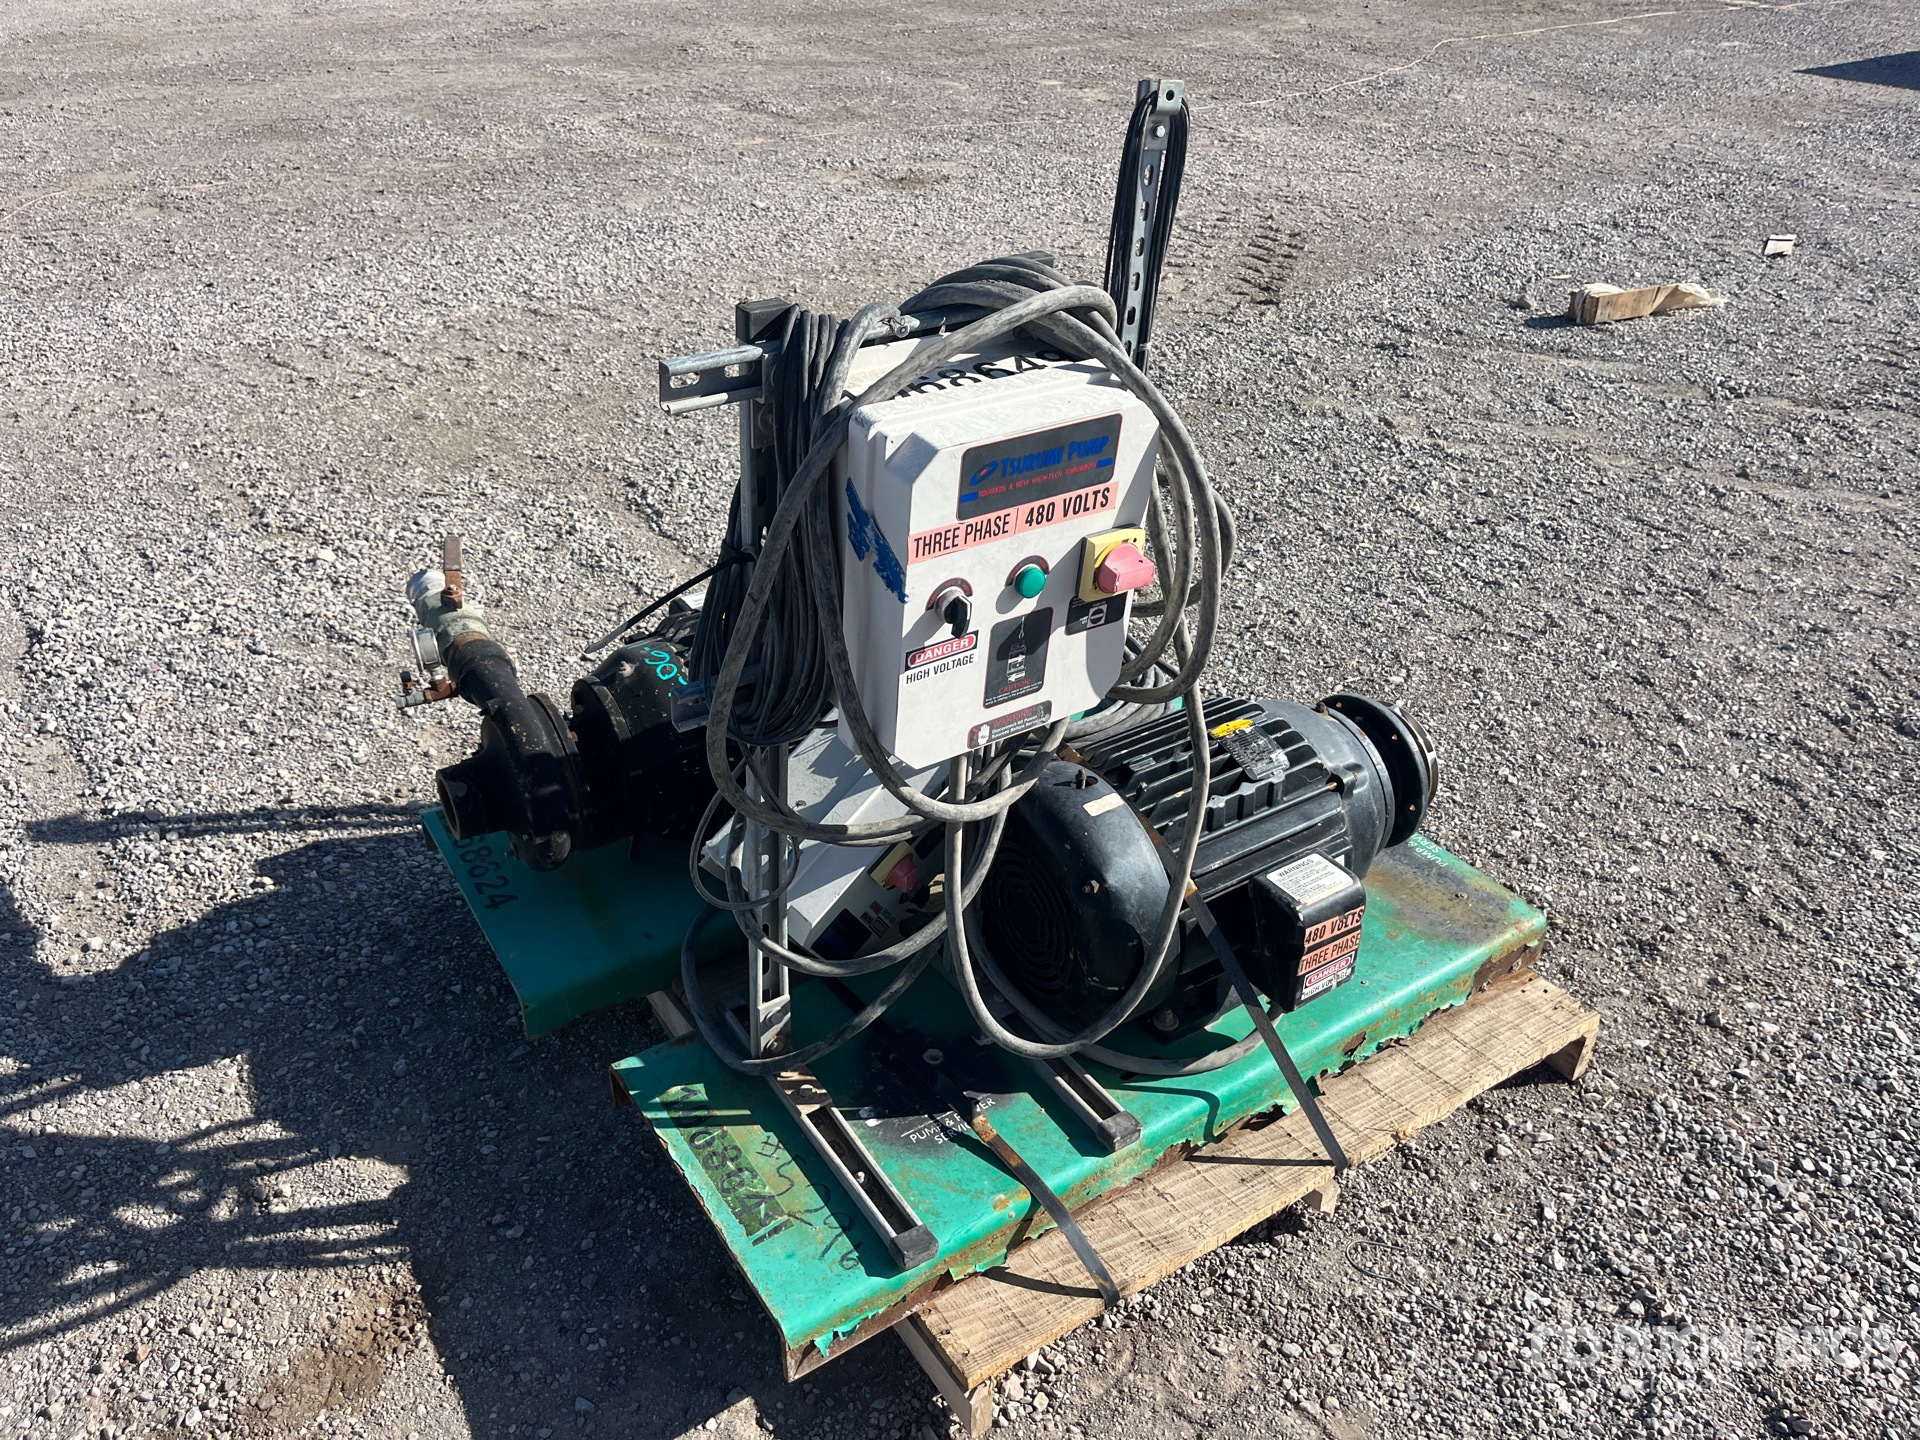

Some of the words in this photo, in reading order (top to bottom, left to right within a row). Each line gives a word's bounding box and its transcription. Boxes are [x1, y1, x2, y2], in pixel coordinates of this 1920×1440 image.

[1000, 445, 1064, 478] TSURUMI
[1067, 435, 1110, 461] PUMP
[978, 484, 1007, 497] TOWARDS
[1015, 479, 1030, 488] NEW
[1065, 462, 1097, 475] TOMORROW
[914, 526, 961, 558] THREE
[964, 513, 1011, 544] PHASE
[1025, 501, 1056, 527] 480
[1062, 487, 1111, 518] VOLTS
[915, 638, 969, 663] DANGER
[905, 668, 930, 685] HIGH
[933, 653, 975, 675] VOLTAGE
[1277, 858, 1314, 878] WARNINGS
[1415, 847, 1449, 868] PUMP
[1305, 924, 1326, 945] 480
[1330, 908, 1364, 934] VOLTS
[1300, 947, 1330, 973] THREE
[1331, 932, 1361, 958] PHASE
[1312, 958, 1347, 983] DANGER
[1303, 985, 1320, 998] HIGH
[909, 1122, 942, 1144] PUMP
[945, 1117, 955, 1127] &
